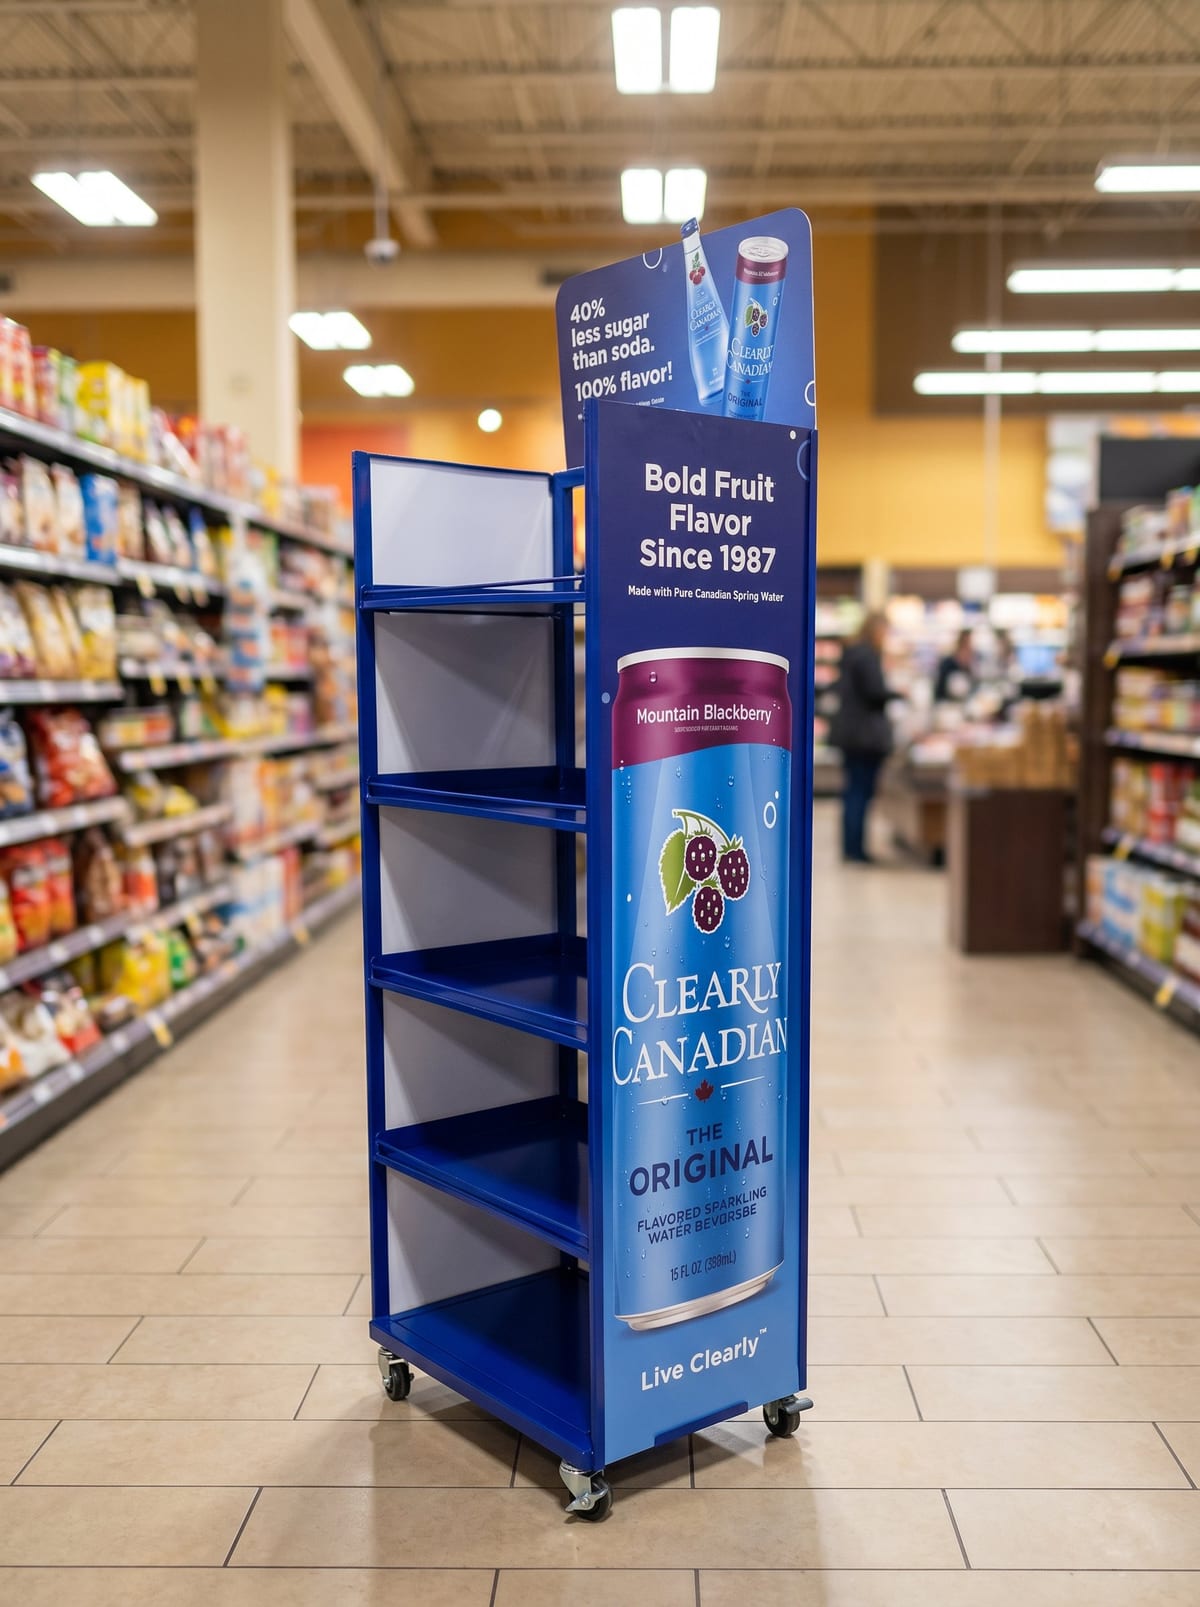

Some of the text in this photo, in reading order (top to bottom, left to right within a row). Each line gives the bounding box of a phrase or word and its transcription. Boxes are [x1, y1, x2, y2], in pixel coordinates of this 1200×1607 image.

[570, 297, 606, 324] 40%
[571, 312, 650, 348] less sugar
[572, 335, 655, 371] than soda.
[731, 338, 774, 363] CLEARLY
[574, 361, 673, 402] 100% flavor!
[727, 392, 763, 408] ORIGINAL
[644, 463, 776, 503] Bold Fruit
[669, 503, 752, 537] Flavor
[639, 538, 776, 574] Since 1987
[628, 584, 785, 604] Made with Pure Canadian Spring Water
[636, 703, 772, 725] Mountain Blackberry
[622, 962, 782, 1024] CLEARLY
[612, 1017, 788, 1086] CANADIAN
[686, 1122, 724, 1146] THE
[629, 1135, 774, 1197] ORIGINAL
[637, 1186, 768, 1233] FLAVORED SPARKLING
[647, 1222, 692, 1245] WATER
[670, 1267, 679, 1282] 15
[680, 1266, 690, 1279] FL
[691, 1260, 703, 1276] OZ
[641, 1362, 684, 1391] Live
